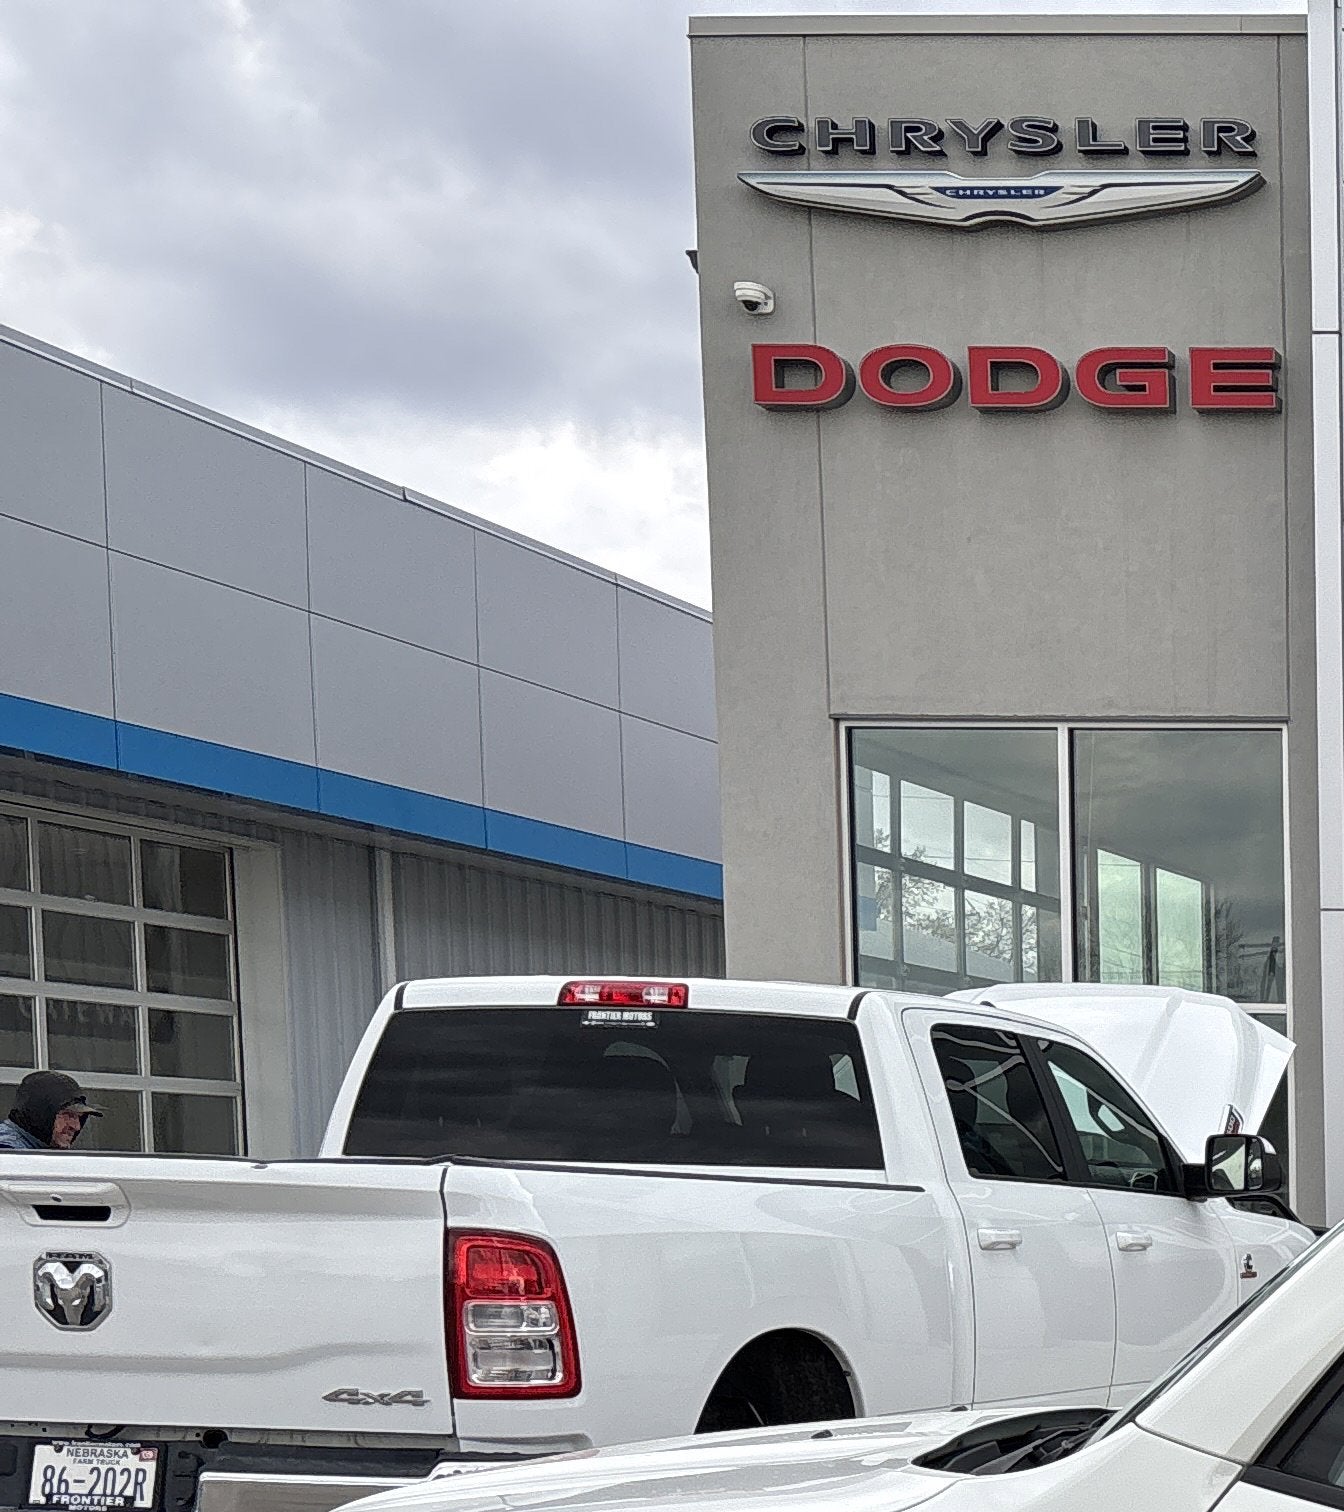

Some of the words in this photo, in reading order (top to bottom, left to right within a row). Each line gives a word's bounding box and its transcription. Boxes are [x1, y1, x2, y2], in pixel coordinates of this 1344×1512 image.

[750, 116, 1257, 156] CHRYSLER
[944, 187, 1047, 197] CHRYSLER
[751, 343, 1282, 413] DODGE
[66, 1448, 129, 1459] NEBRASKA
[41, 1464, 147, 1502] 86-202R
[52, 1495, 125, 1507] FRONTIER
[68, 1504, 108, 1512] MOTORS
